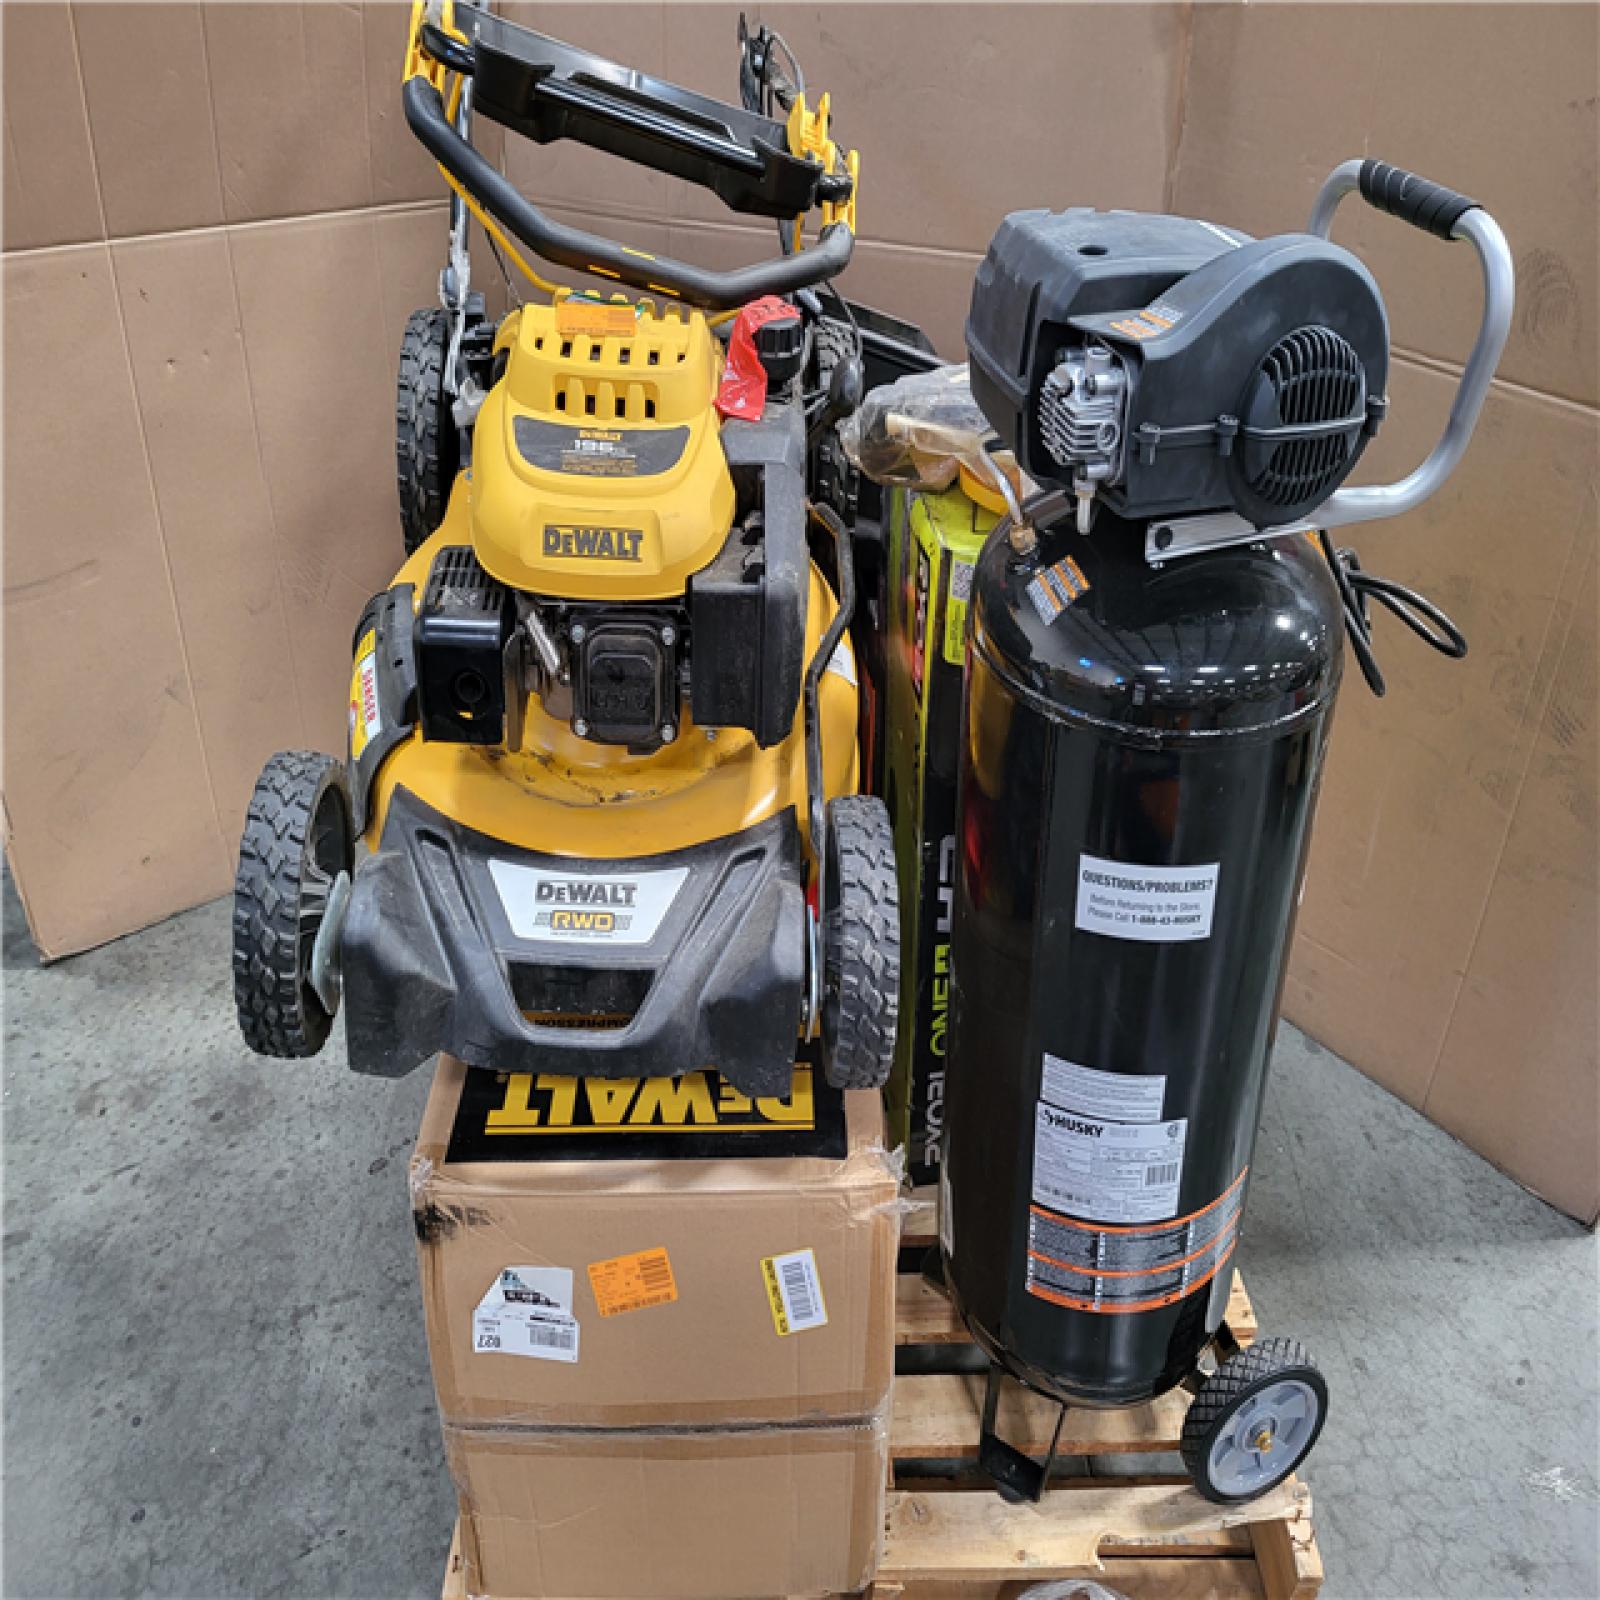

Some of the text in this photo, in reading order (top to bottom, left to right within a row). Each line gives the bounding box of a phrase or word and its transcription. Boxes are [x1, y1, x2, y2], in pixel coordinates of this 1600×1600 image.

[543, 524, 643, 560] DEWALT
[535, 881, 638, 904] DEWALT
[1082, 869, 1214, 893] QUESTIONS/PROBLEMS?
[552, 912, 614, 931] RWD
[1054, 1113, 1104, 1138] HUSKY
